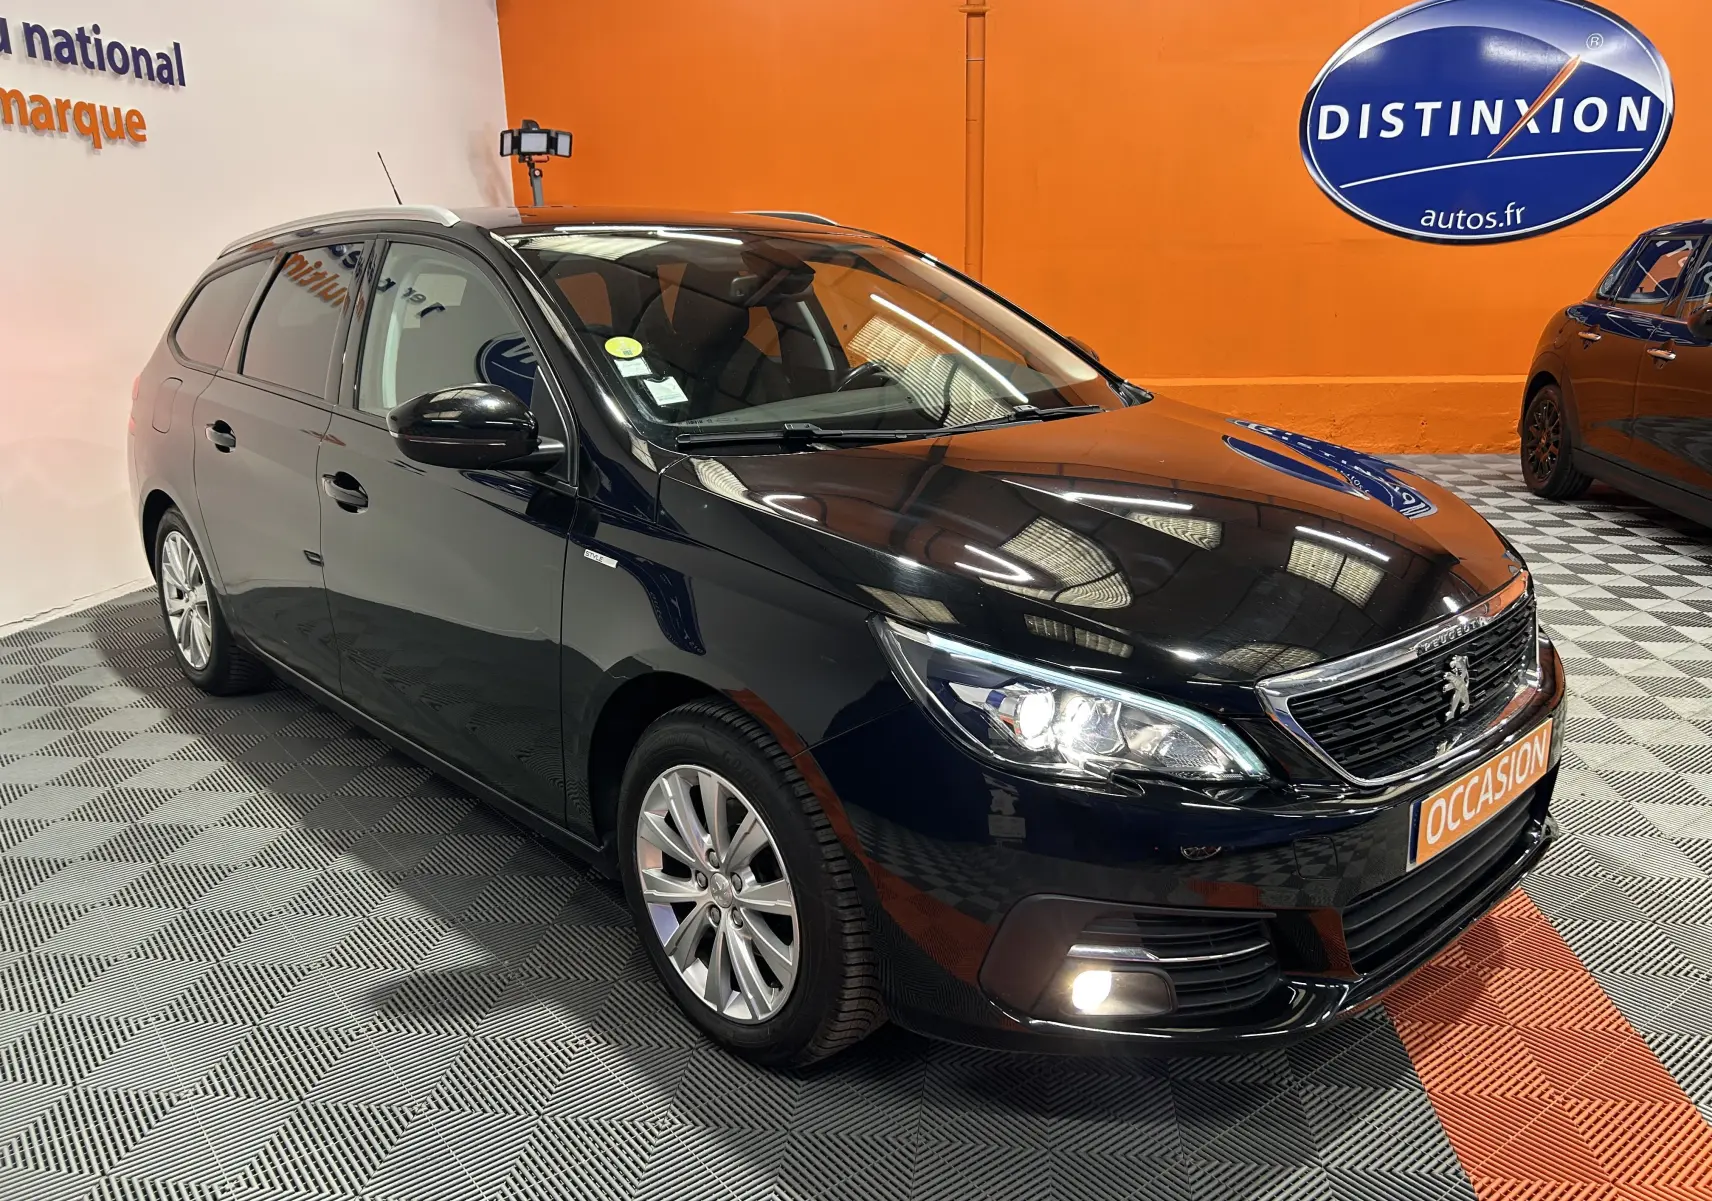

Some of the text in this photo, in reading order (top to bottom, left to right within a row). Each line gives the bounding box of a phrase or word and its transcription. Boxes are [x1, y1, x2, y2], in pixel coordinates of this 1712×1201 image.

[22, 21, 186, 87] national
[1317, 94, 1652, 141] DISTINXION
[1420, 201, 1526, 231] autos.fr
[585, 550, 604, 563] STYLE
[1423, 618, 1479, 652] PEUGEOT
[1426, 729, 1547, 845] OCCASION
